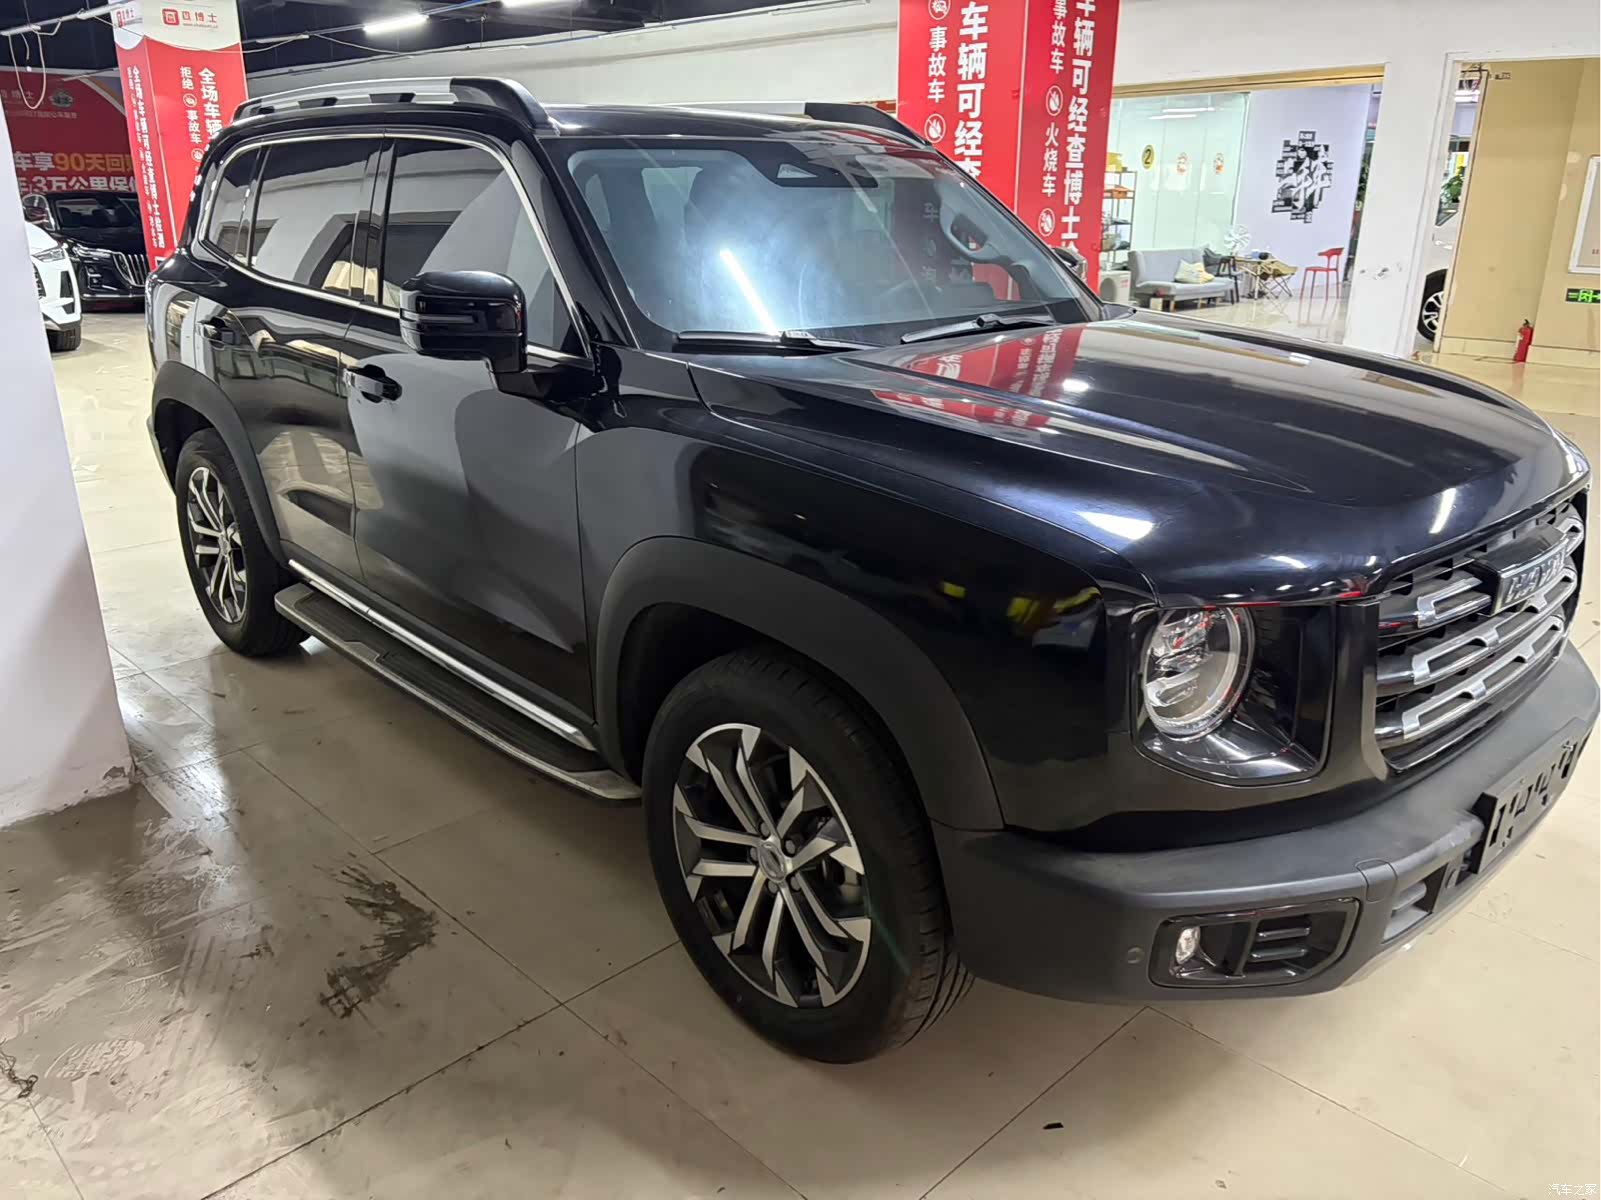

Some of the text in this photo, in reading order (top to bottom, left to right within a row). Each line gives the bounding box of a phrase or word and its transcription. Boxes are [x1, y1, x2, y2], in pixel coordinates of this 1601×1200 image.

[180, 66, 194, 89] 拒绝
[928, 26, 947, 103] 事故车
[187, 110, 202, 144] 事故车
[1042, 122, 1060, 197] 火烧车
[1061, 0, 1096, 252] 辆可经查博士
